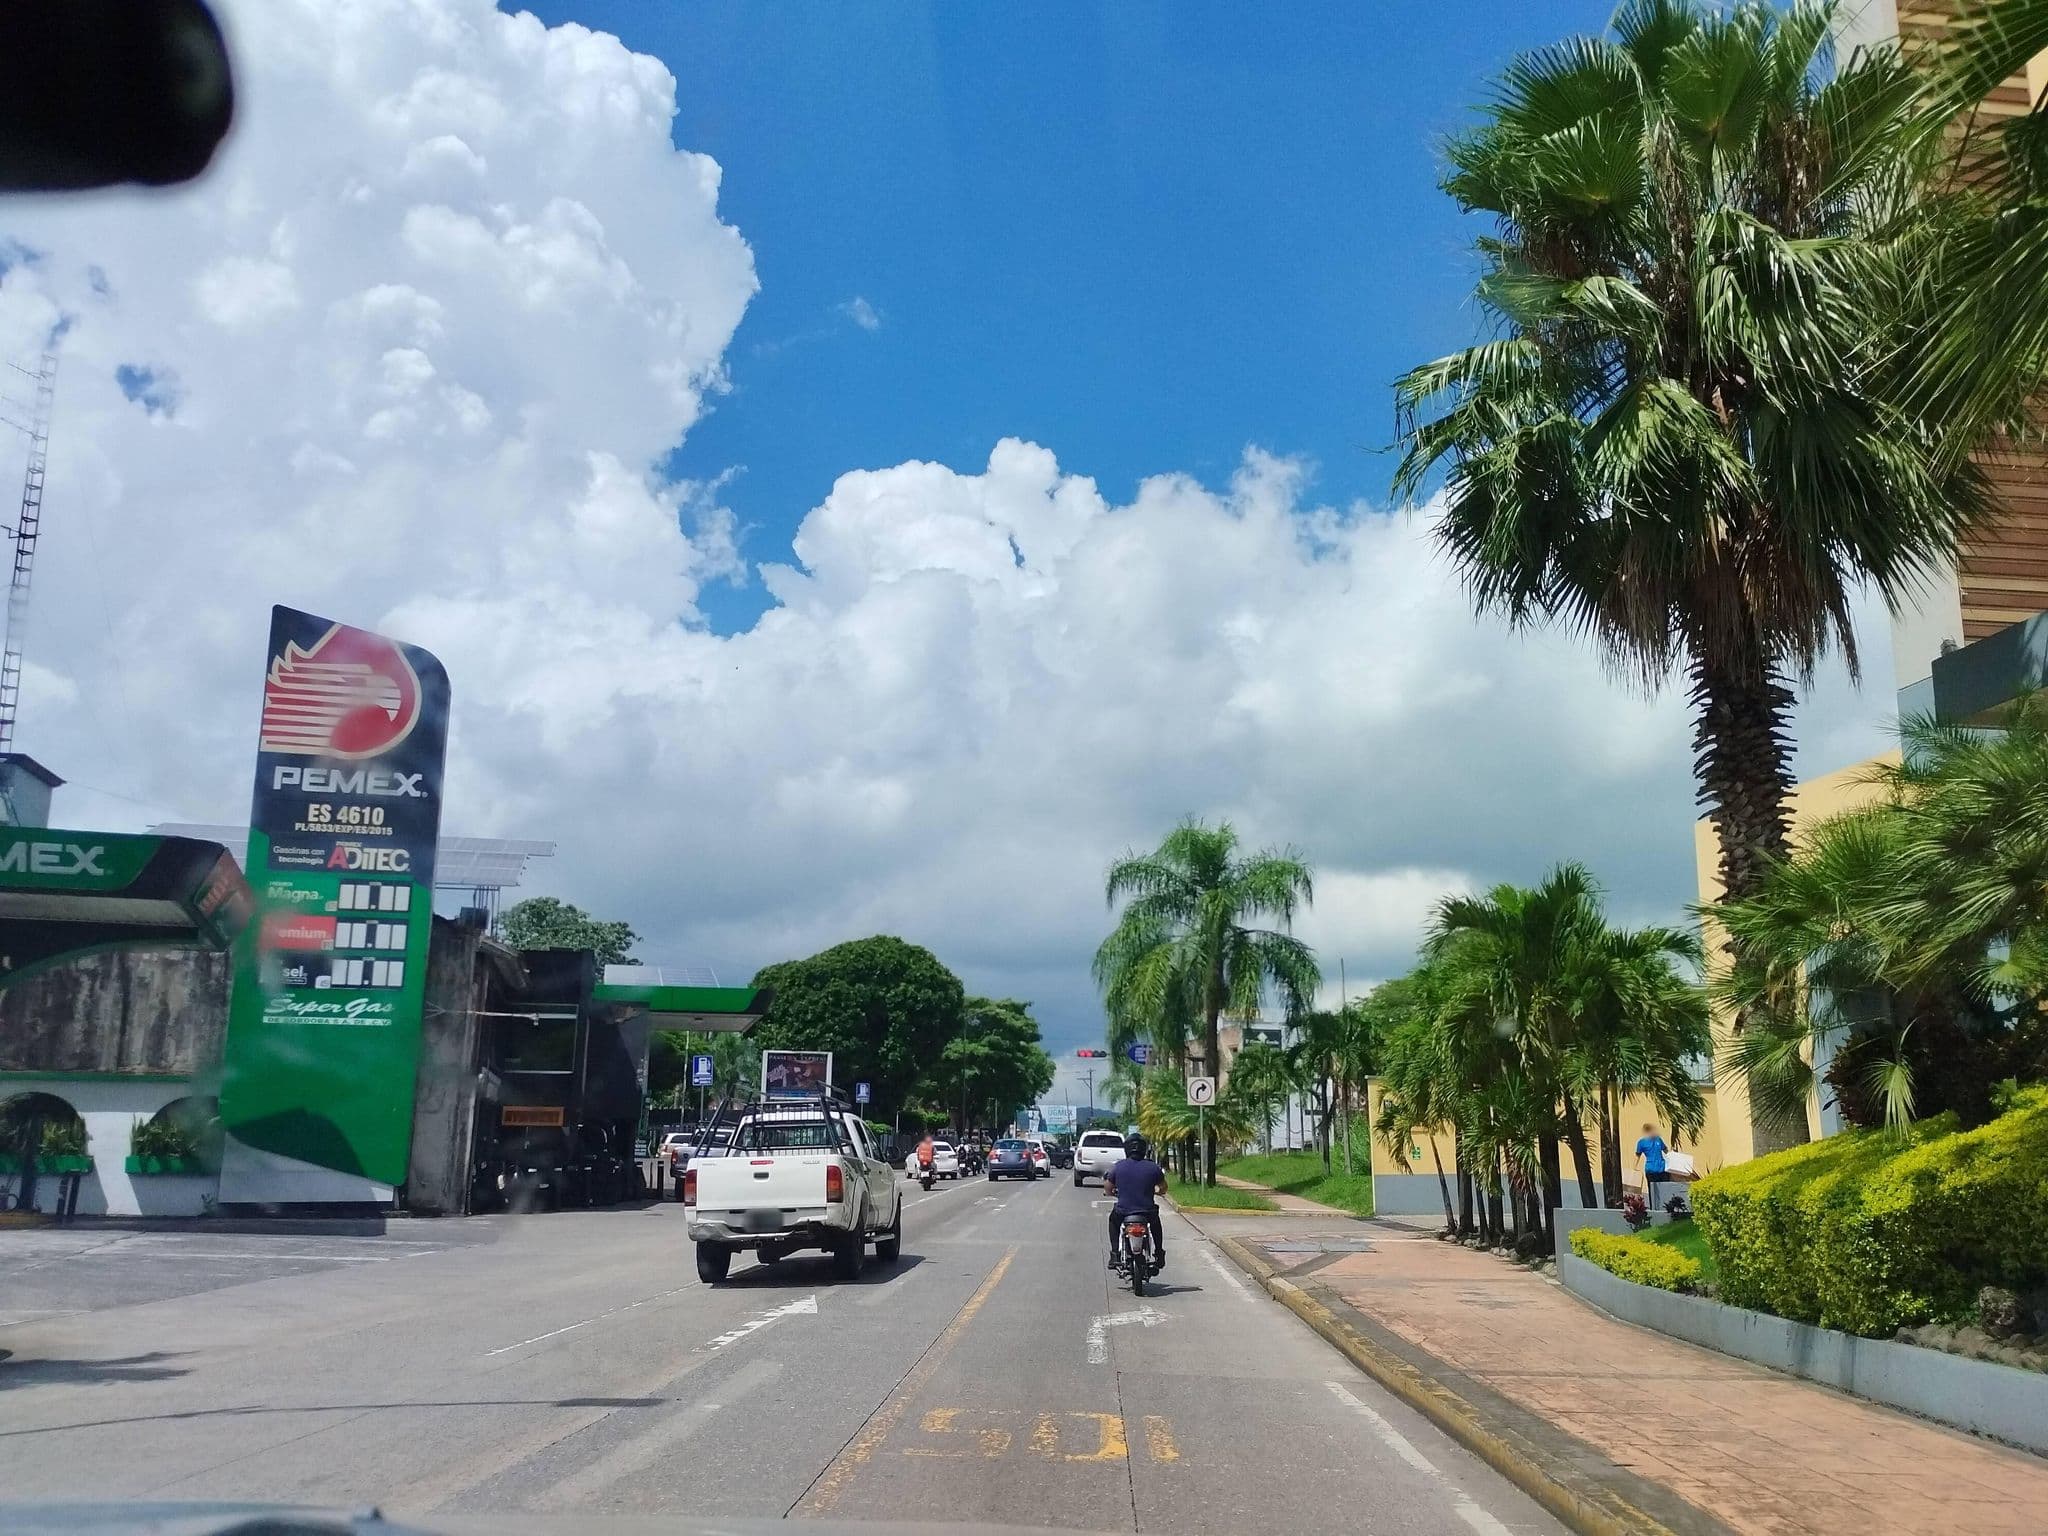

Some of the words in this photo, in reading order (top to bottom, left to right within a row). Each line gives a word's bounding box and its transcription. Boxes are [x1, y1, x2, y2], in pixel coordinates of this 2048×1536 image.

[272, 765, 423, 798] PEMEX
[307, 803, 332, 823] ES
[336, 805, 385, 825] 4610
[0, 841, 105, 876] MEX
[267, 886, 320, 902] Magna
[276, 926, 327, 939] emium
